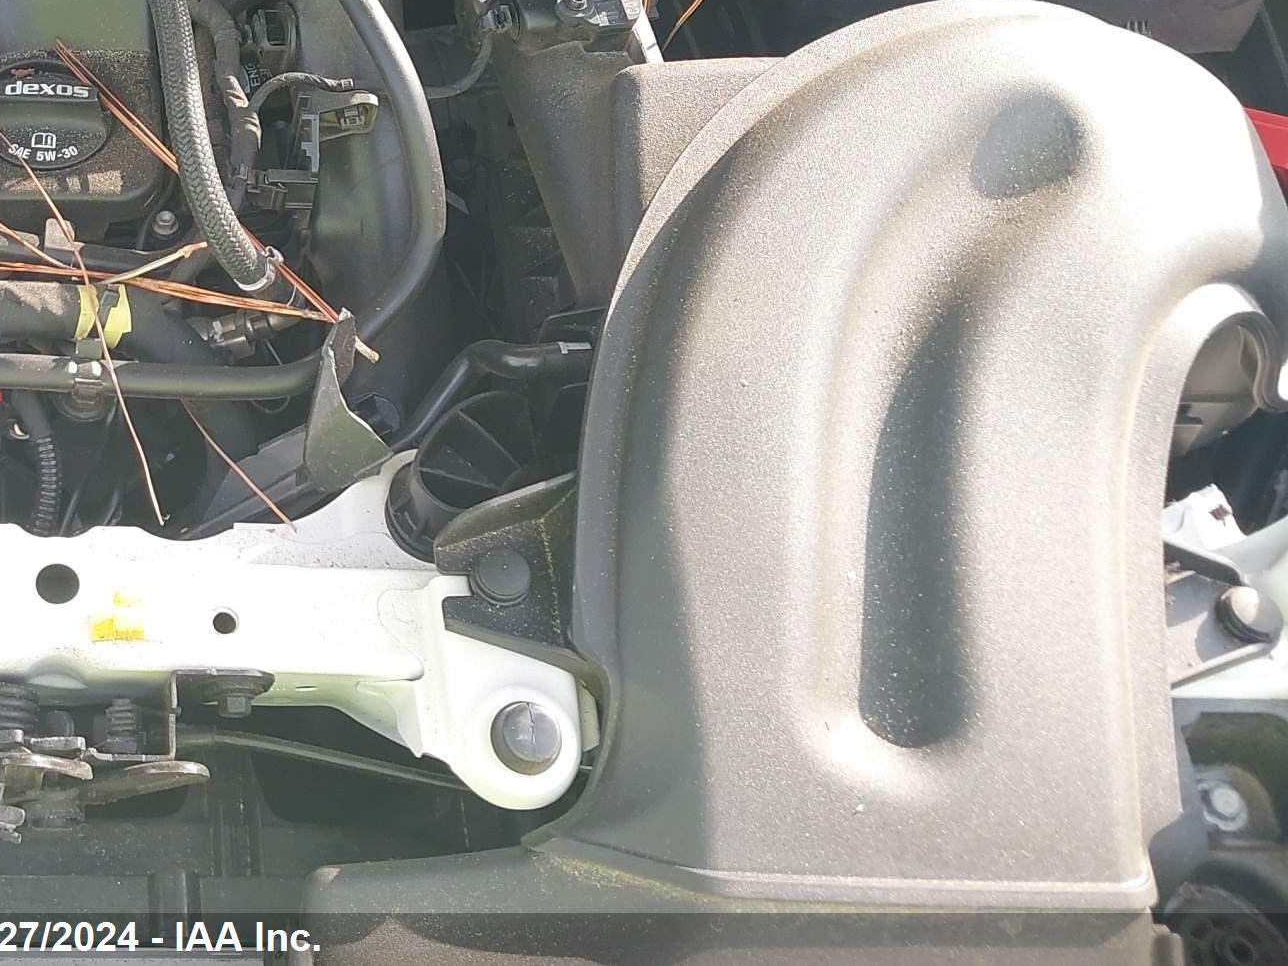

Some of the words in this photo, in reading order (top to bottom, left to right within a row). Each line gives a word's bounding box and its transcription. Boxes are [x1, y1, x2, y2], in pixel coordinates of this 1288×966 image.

[4, 80, 91, 98] dexos
[7, 143, 31, 160] SAE
[35, 145, 79, 162] 5W-30
